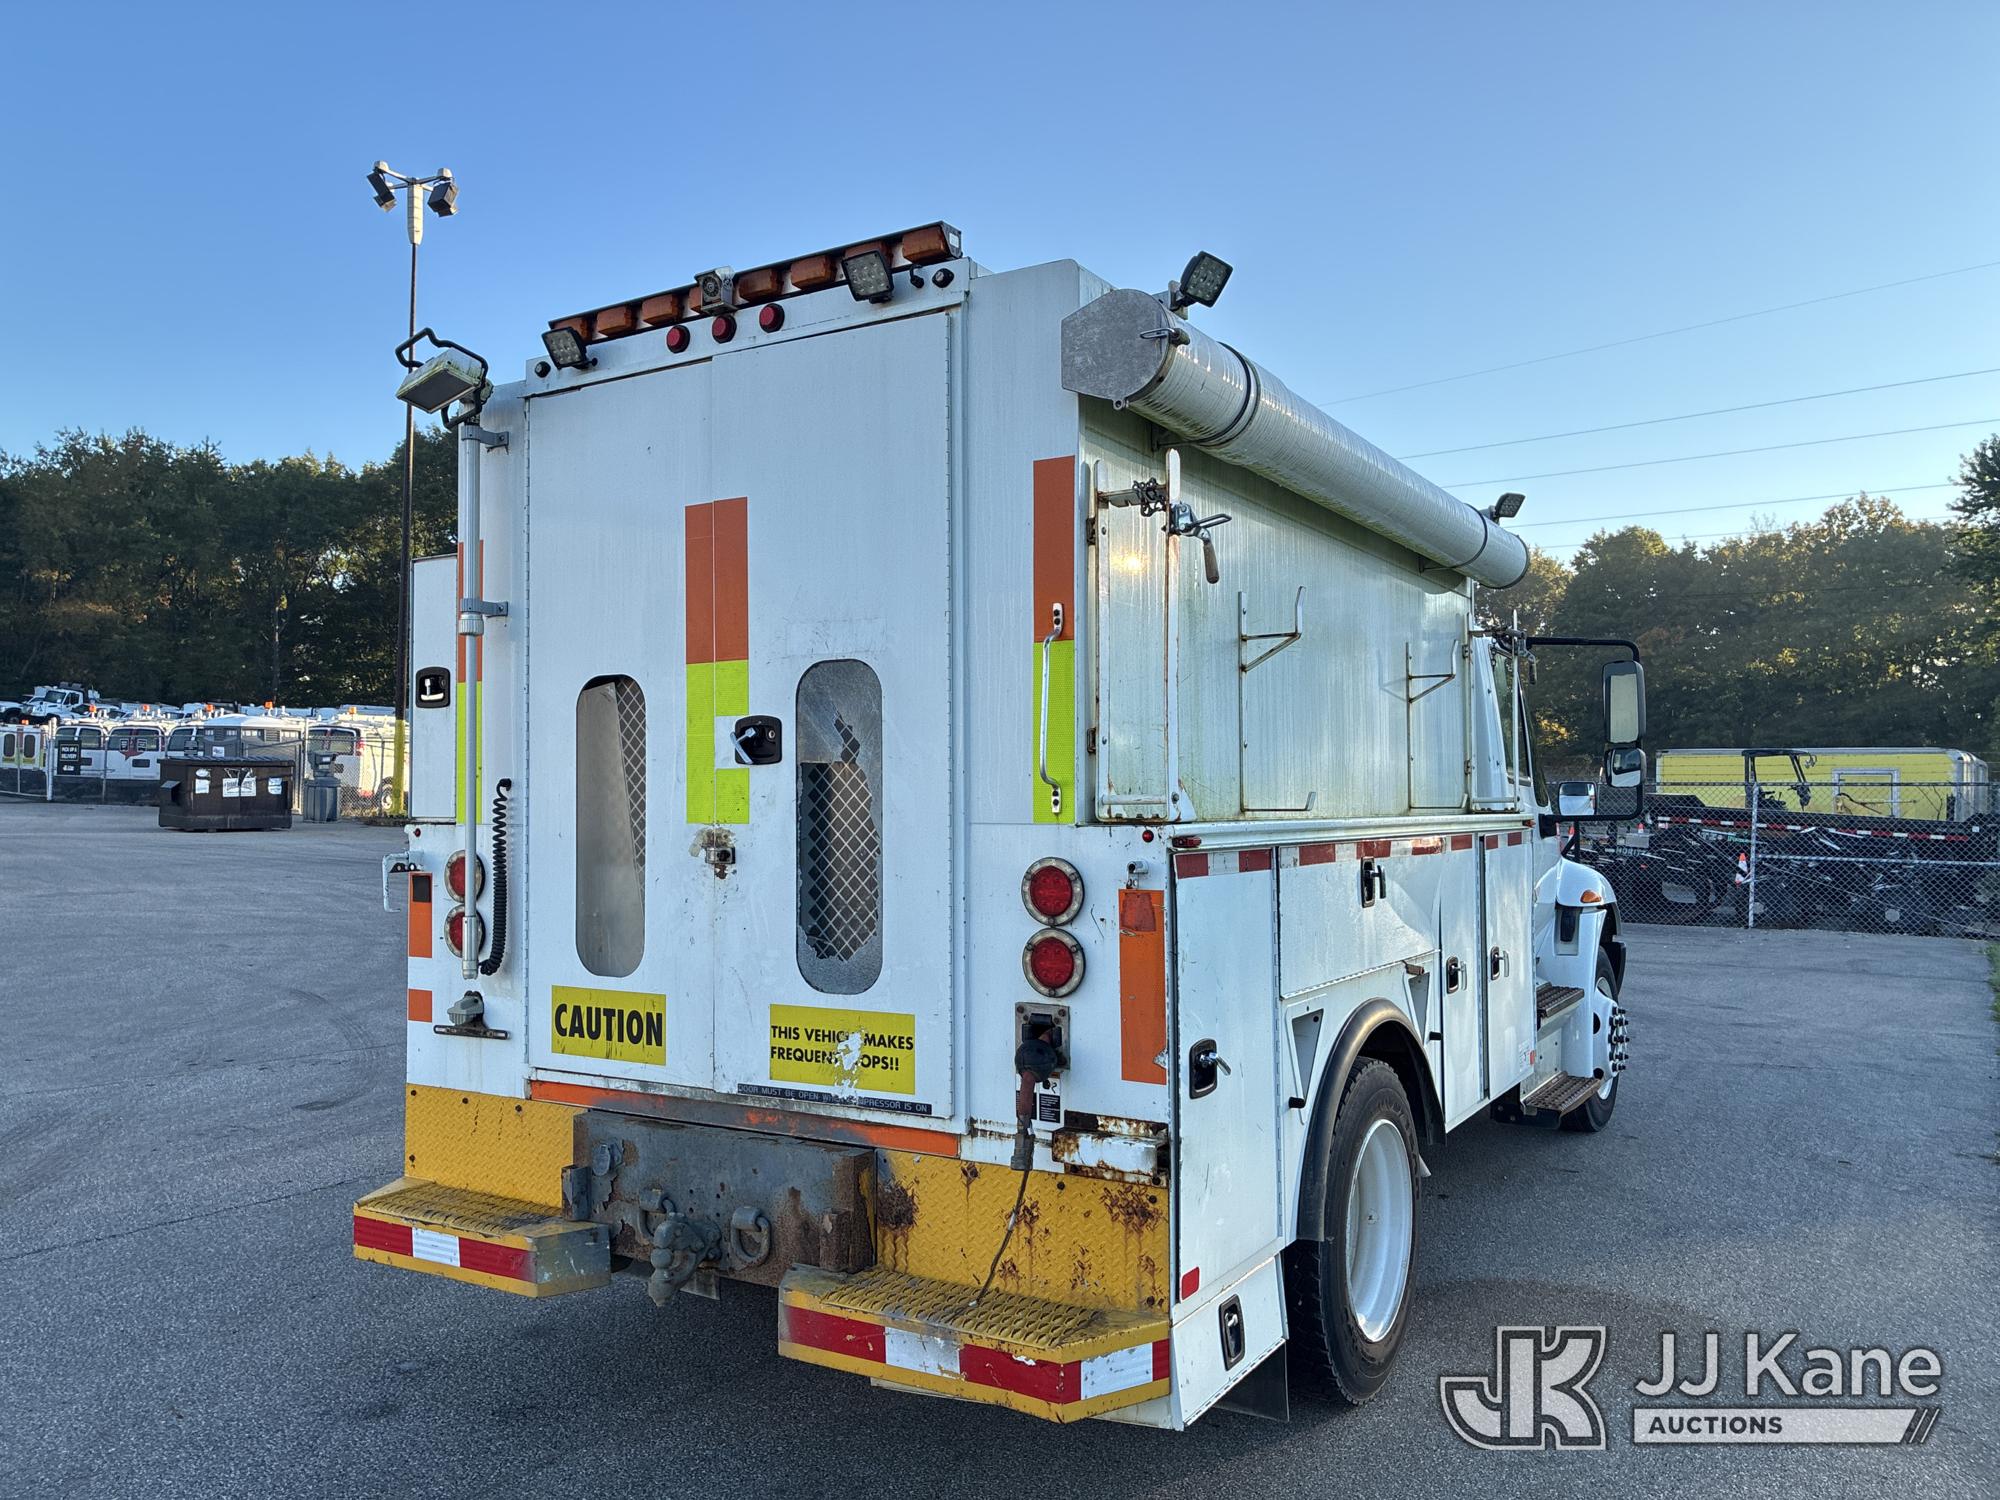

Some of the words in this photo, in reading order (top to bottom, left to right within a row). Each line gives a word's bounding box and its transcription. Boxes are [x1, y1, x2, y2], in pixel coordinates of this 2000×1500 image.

[554, 1003, 663, 1047] CAUTION
[771, 1025, 800, 1041] THIS
[804, 1028, 857, 1044] VEHIC
[863, 1033, 914, 1051] MAKES
[847, 1053, 899, 1071] OPS!!
[738, 1084, 759, 1093] DOOR
[761, 1086, 781, 1096] MUST
[785, 1089, 797, 1098] BE
[798, 1091, 819, 1100] OPEN
[904, 1102, 912, 1110] IS
[915, 1104, 927, 1112] ON
